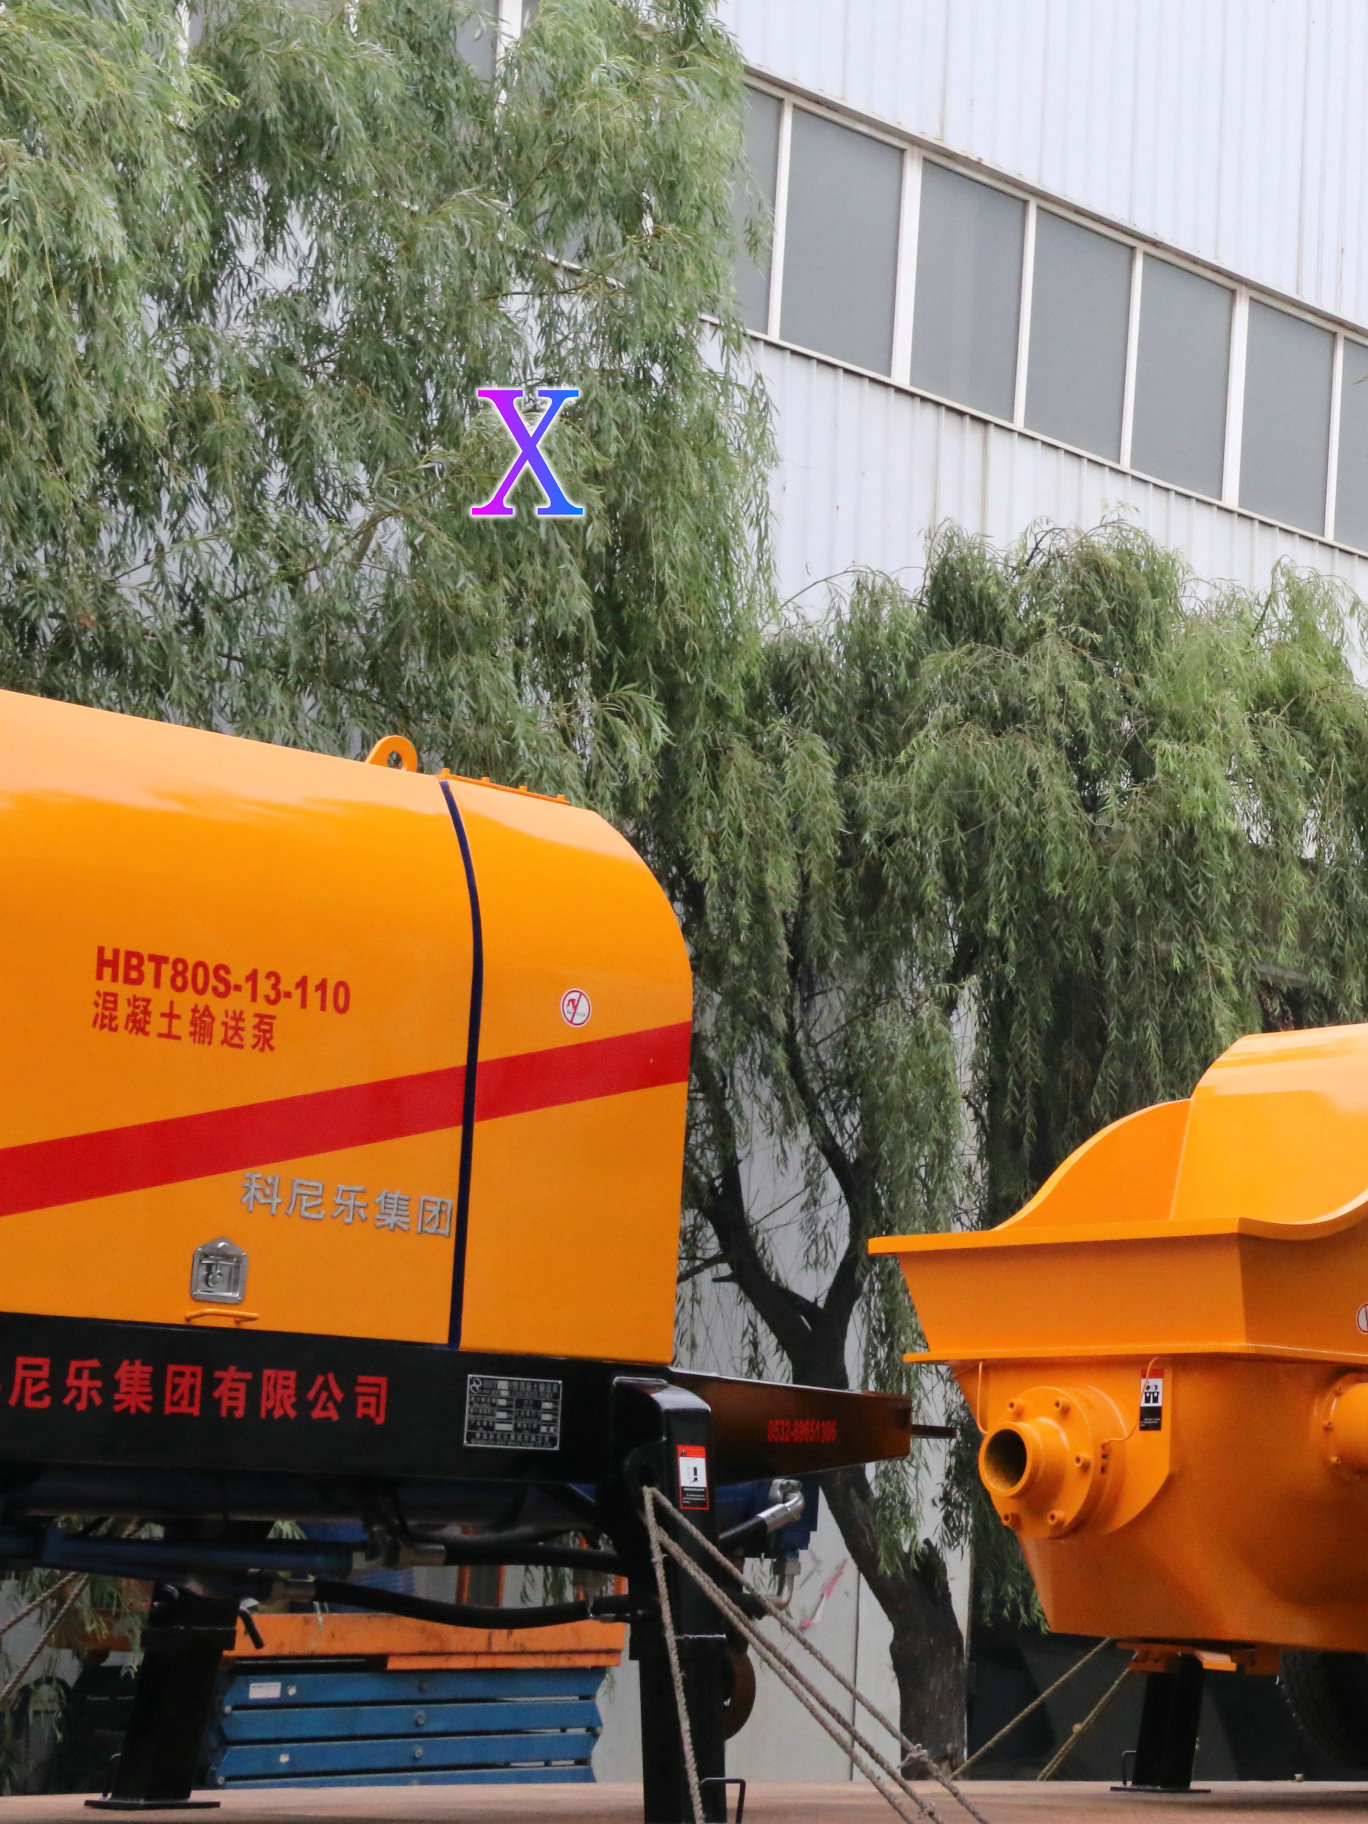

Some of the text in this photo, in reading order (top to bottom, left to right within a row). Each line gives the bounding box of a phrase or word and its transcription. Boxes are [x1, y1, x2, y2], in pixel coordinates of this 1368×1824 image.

[95, 945, 352, 1015] HBT80S-13-110
[91, 989, 278, 1053] 混凝土输送泵
[241, 1172, 454, 1238] 科尼乐集团
